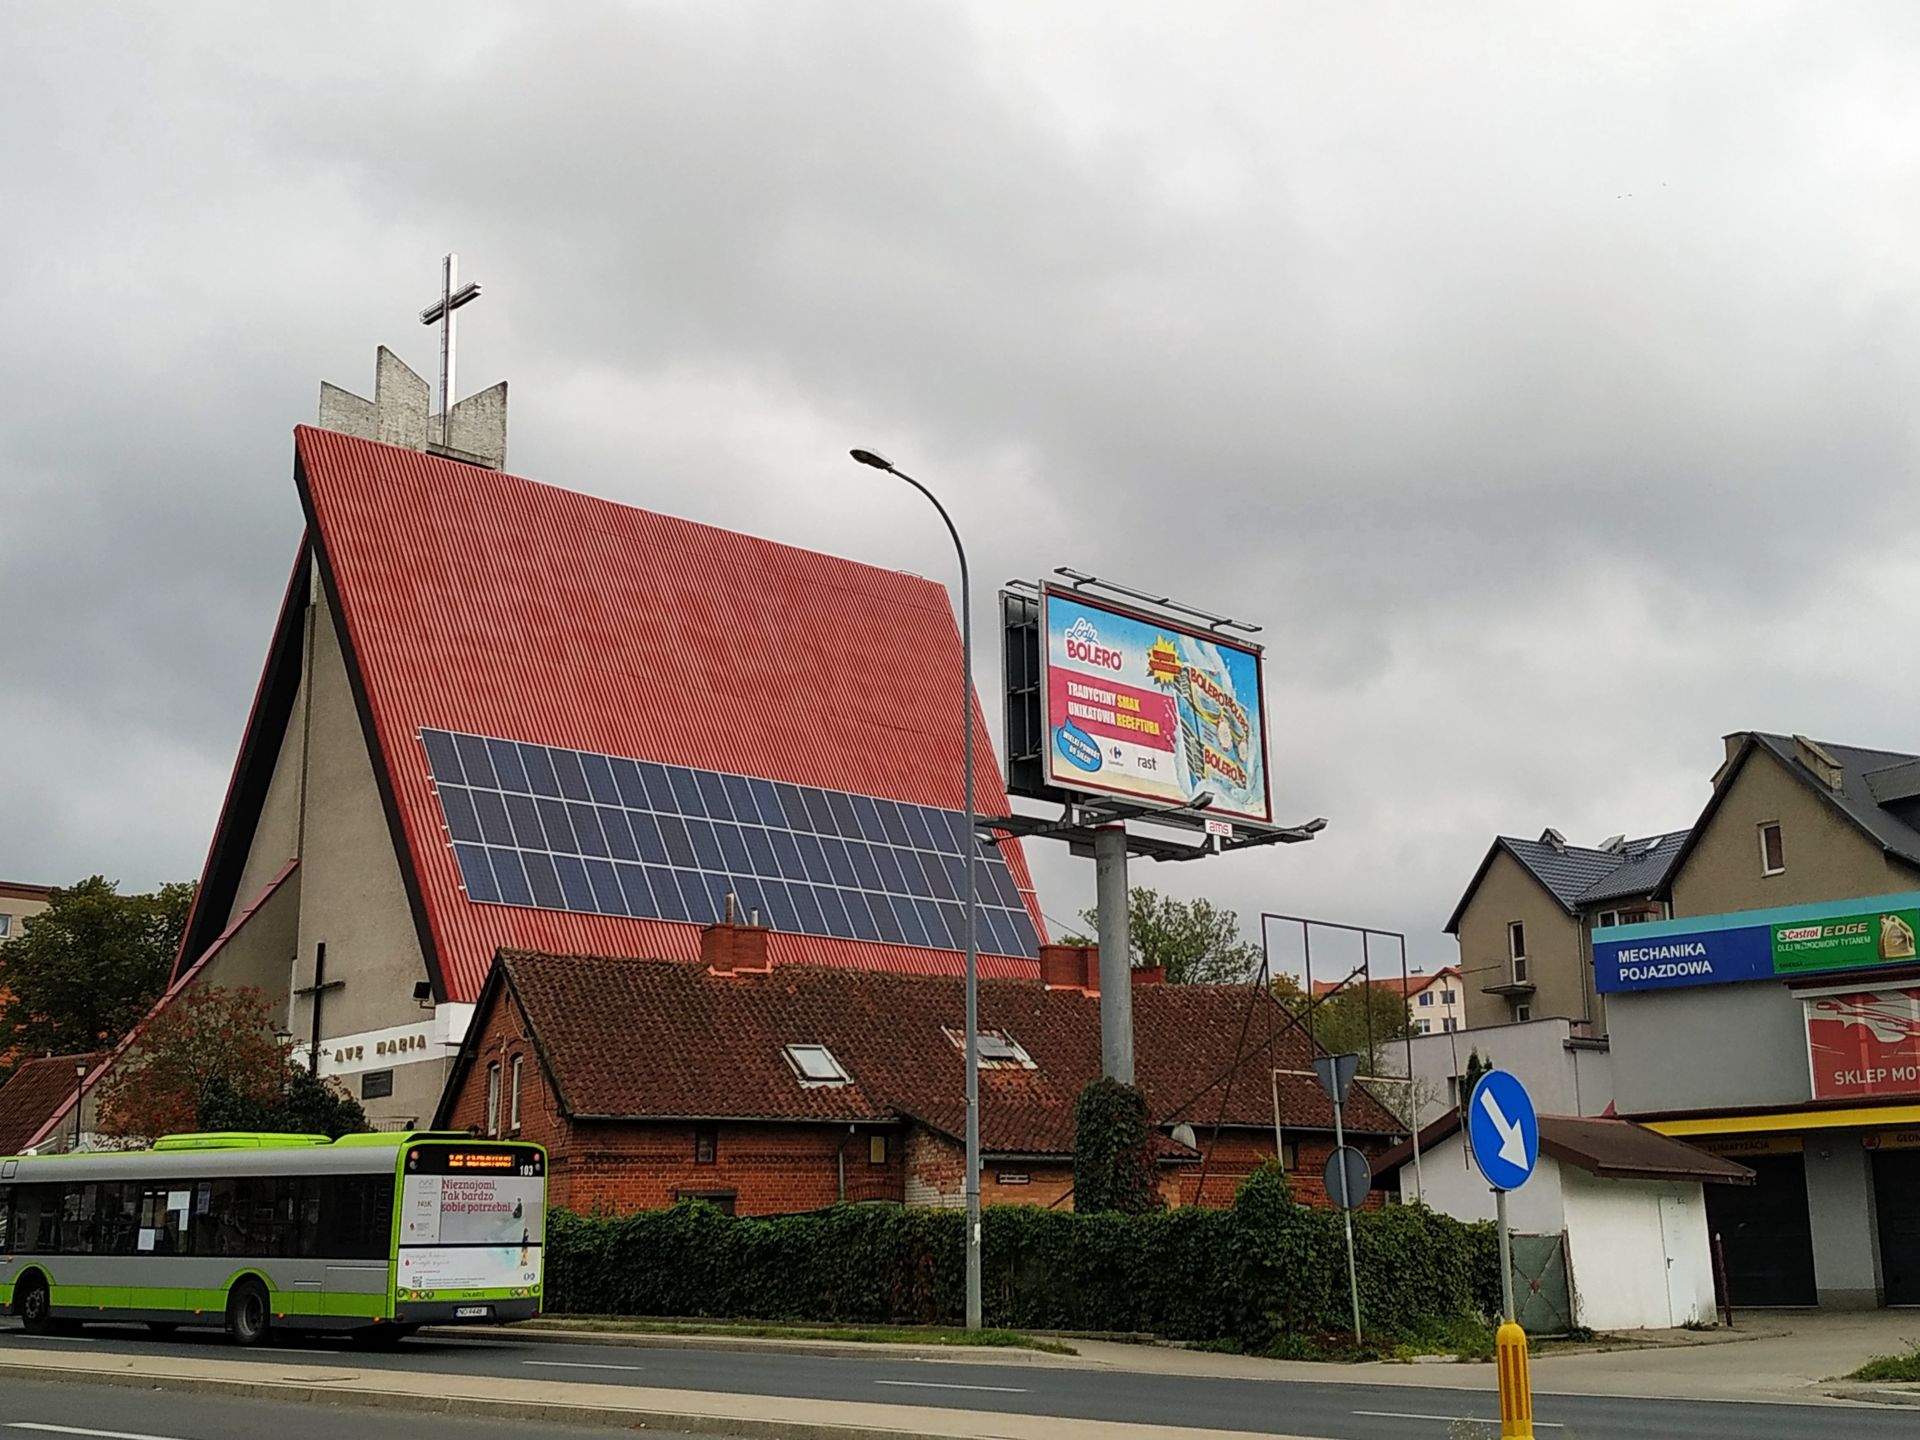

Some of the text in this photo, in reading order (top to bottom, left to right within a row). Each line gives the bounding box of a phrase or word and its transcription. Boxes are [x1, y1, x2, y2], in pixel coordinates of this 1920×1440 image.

[1066, 620, 1099, 644] Lady
[1066, 639, 1122, 671] BOLERO
[1190, 667, 1224, 706] BOLERO
[1117, 694, 1140, 713] SMAK
[1067, 701, 1160, 736] UNIKATOWA RECEPTURA
[1137, 756, 1157, 771] rast
[1204, 748, 1237, 781] BOLERO
[1208, 821, 1230, 835] ams
[1788, 922, 1869, 940] Castrol EDGE
[1618, 942, 1706, 963] MECHANIKA
[1777, 935, 1872, 952] OLEJ WZMOCNIONY TYTANEM
[1620, 960, 1713, 982] POJAZDOWA
[334, 1034, 427, 1063] AVE MARIA
[1834, 1068, 1887, 1085] SKLEP
[520, 1165, 533, 1176] 103
[442, 1178, 497, 1192] Nieznajomi,
[442, 1190, 494, 1201] Tak bardzo
[441, 1202, 466, 1212] sobie
[467, 1202, 513, 1214] potrzebni.
